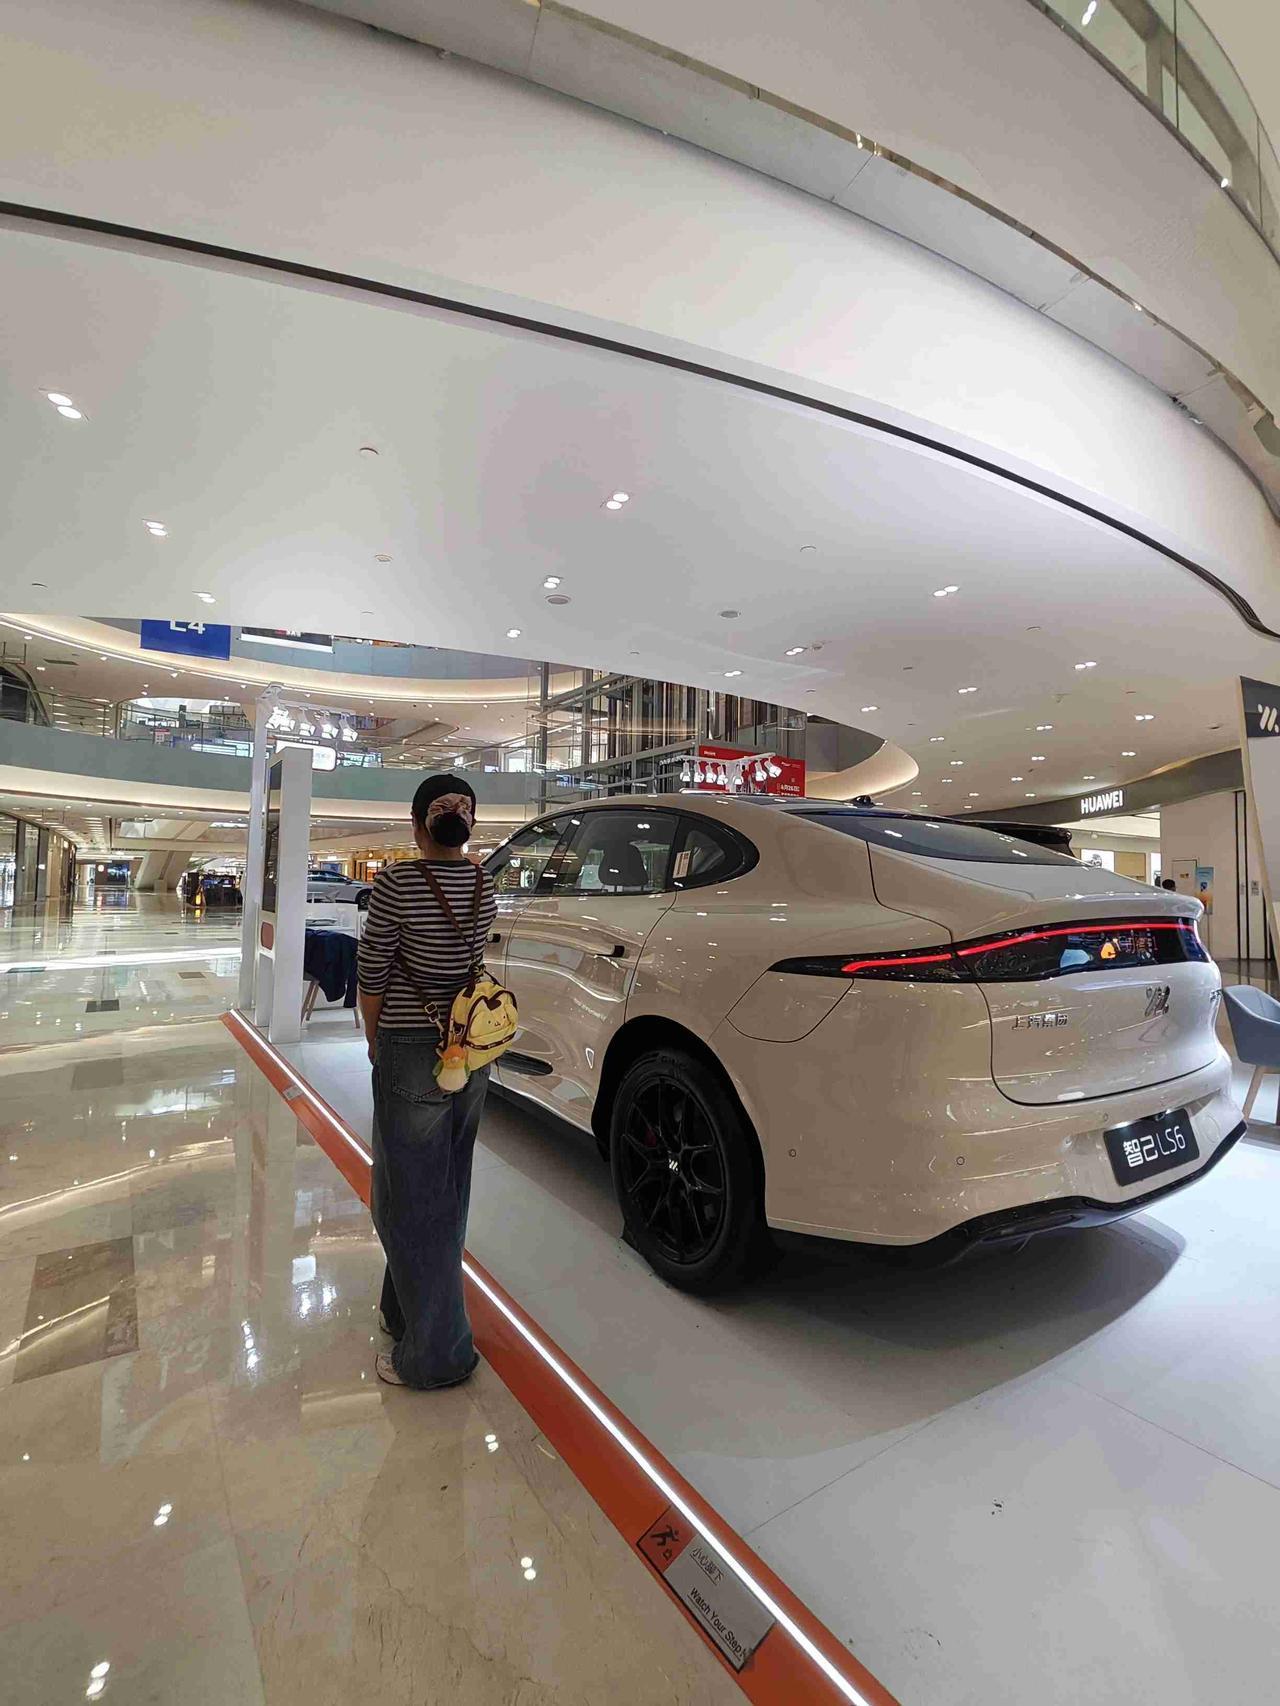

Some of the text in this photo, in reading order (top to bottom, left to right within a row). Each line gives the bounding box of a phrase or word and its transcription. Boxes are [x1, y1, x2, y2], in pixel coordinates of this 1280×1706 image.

[1080, 789, 1123, 814] HUAWEI
[691, 1587, 711, 1615] Watch
[710, 1611, 727, 1633] Your
